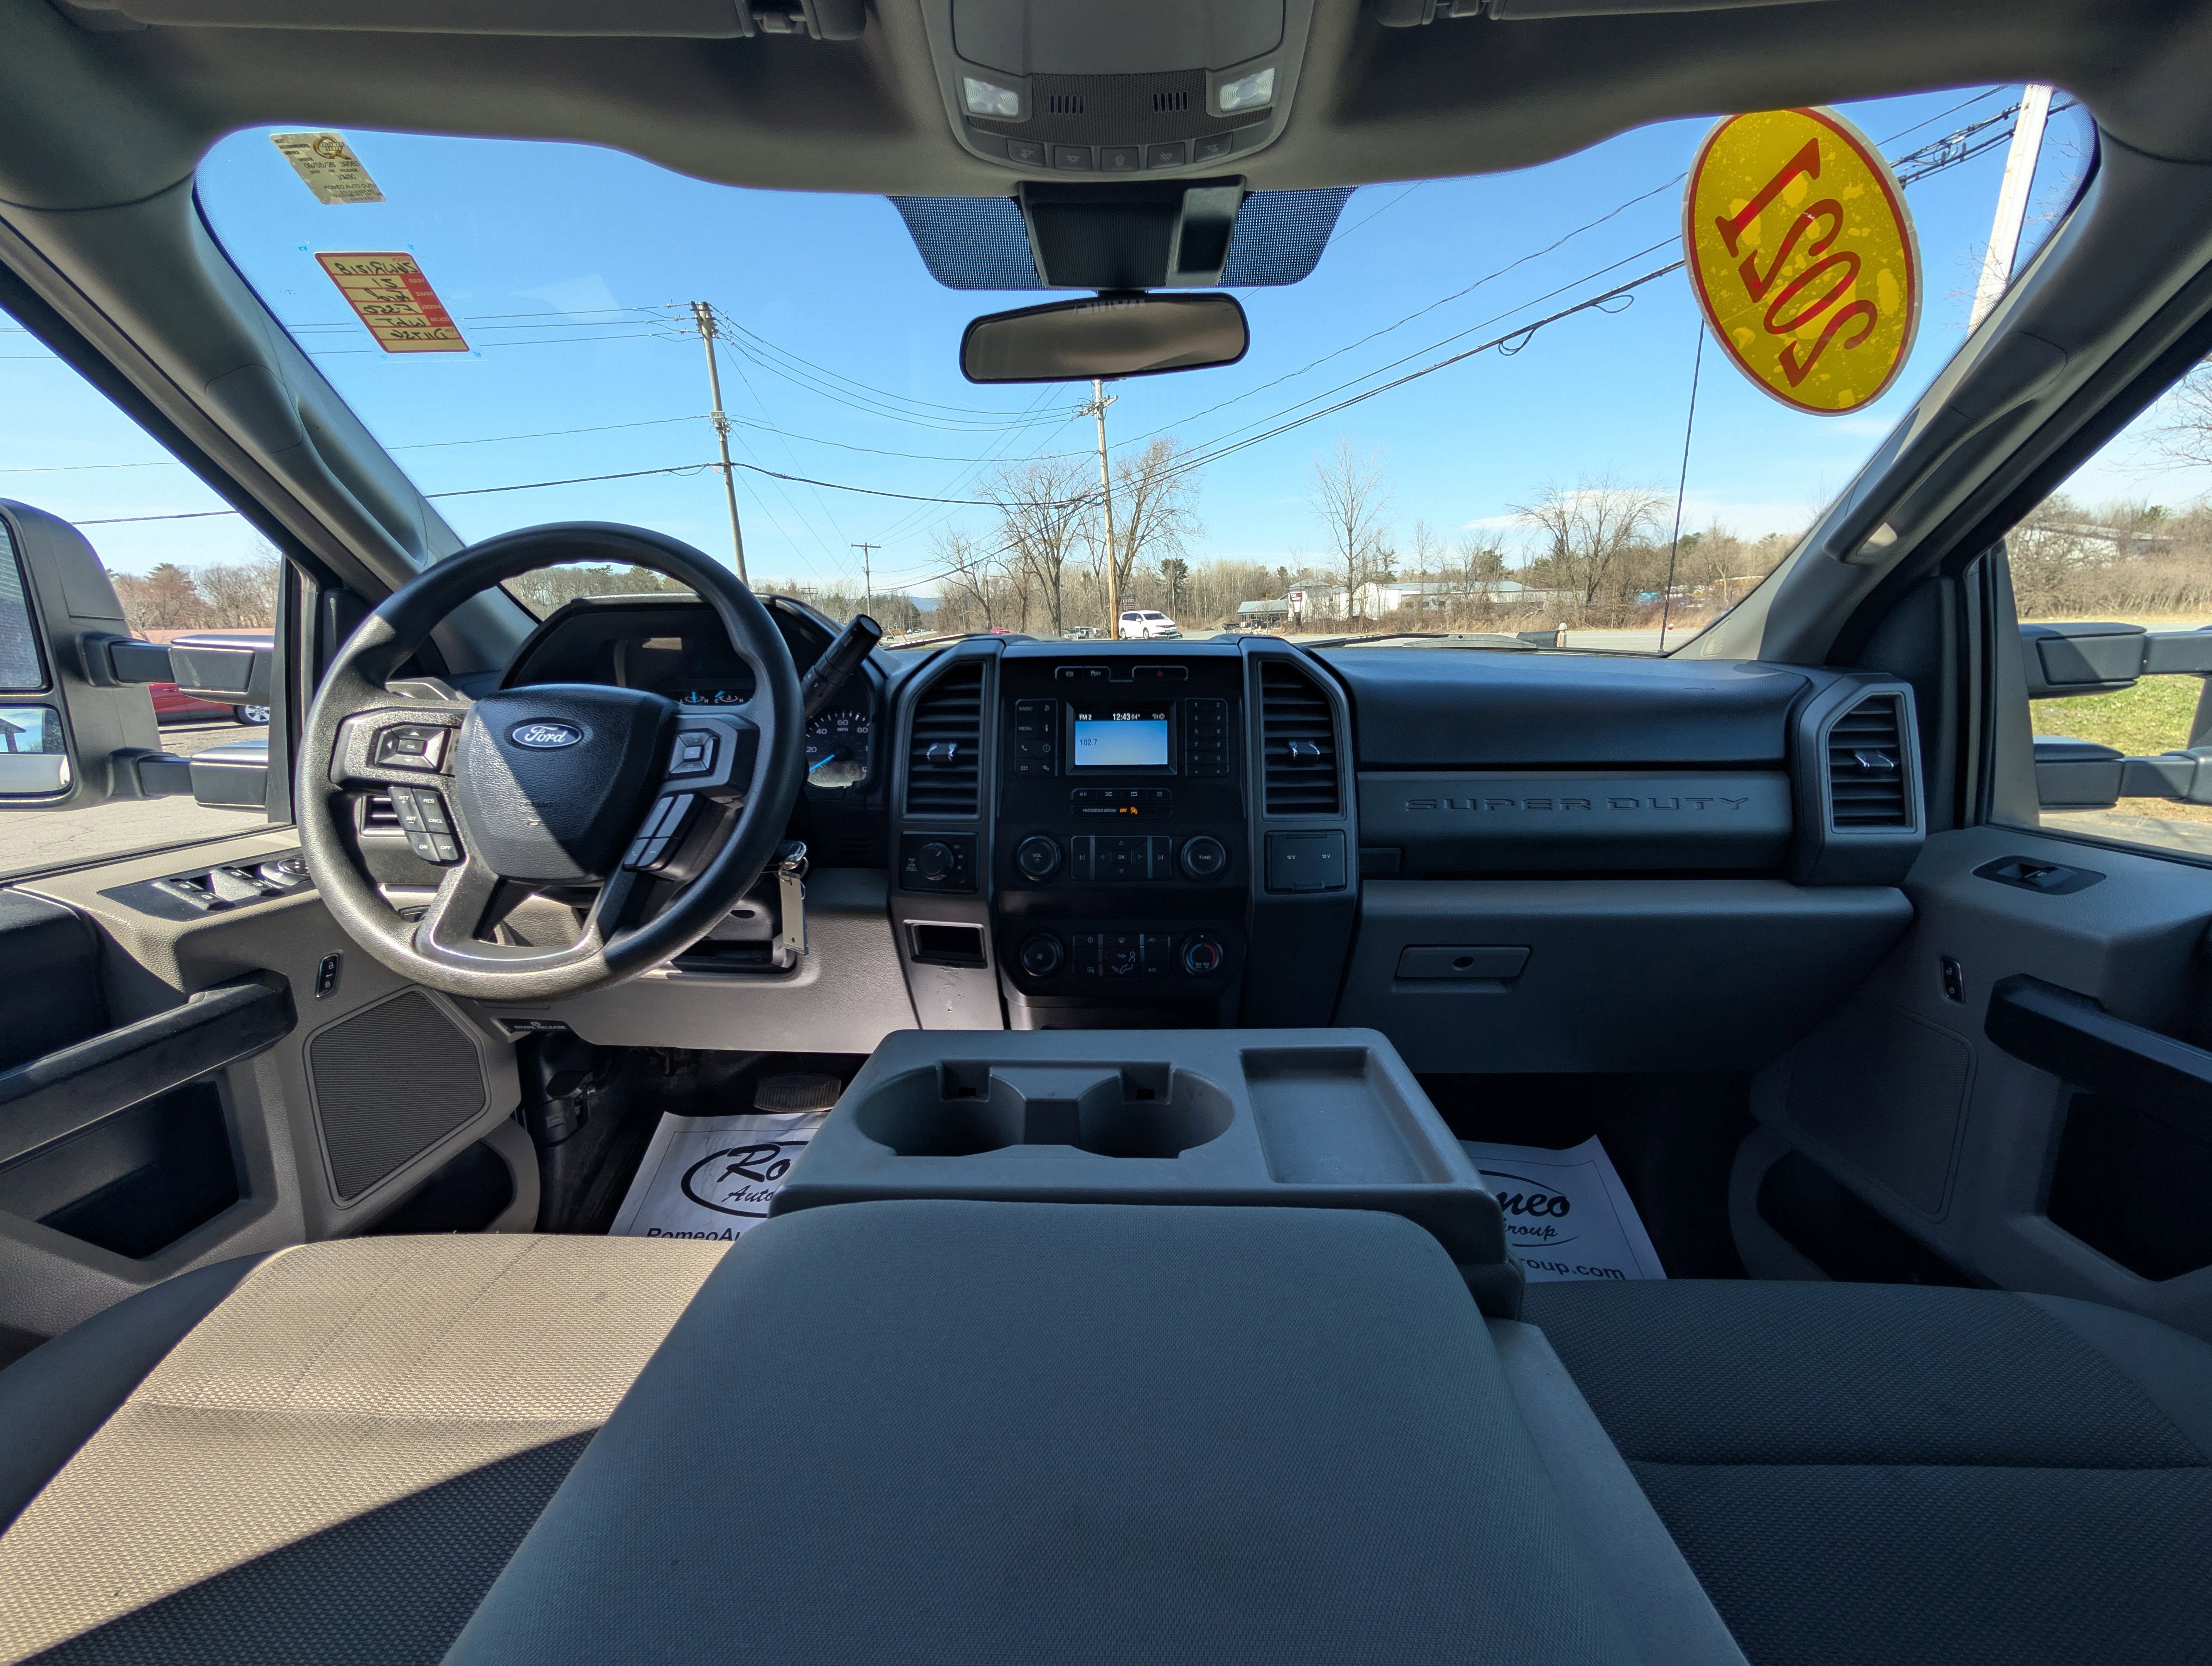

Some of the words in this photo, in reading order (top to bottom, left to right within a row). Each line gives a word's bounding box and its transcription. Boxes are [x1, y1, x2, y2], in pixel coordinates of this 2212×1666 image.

[524, 726, 567, 744] Ford
[1405, 798, 1591, 813] SUPER
[1606, 796, 1749, 812] DUTY
[1503, 1217, 1559, 1241] roup
